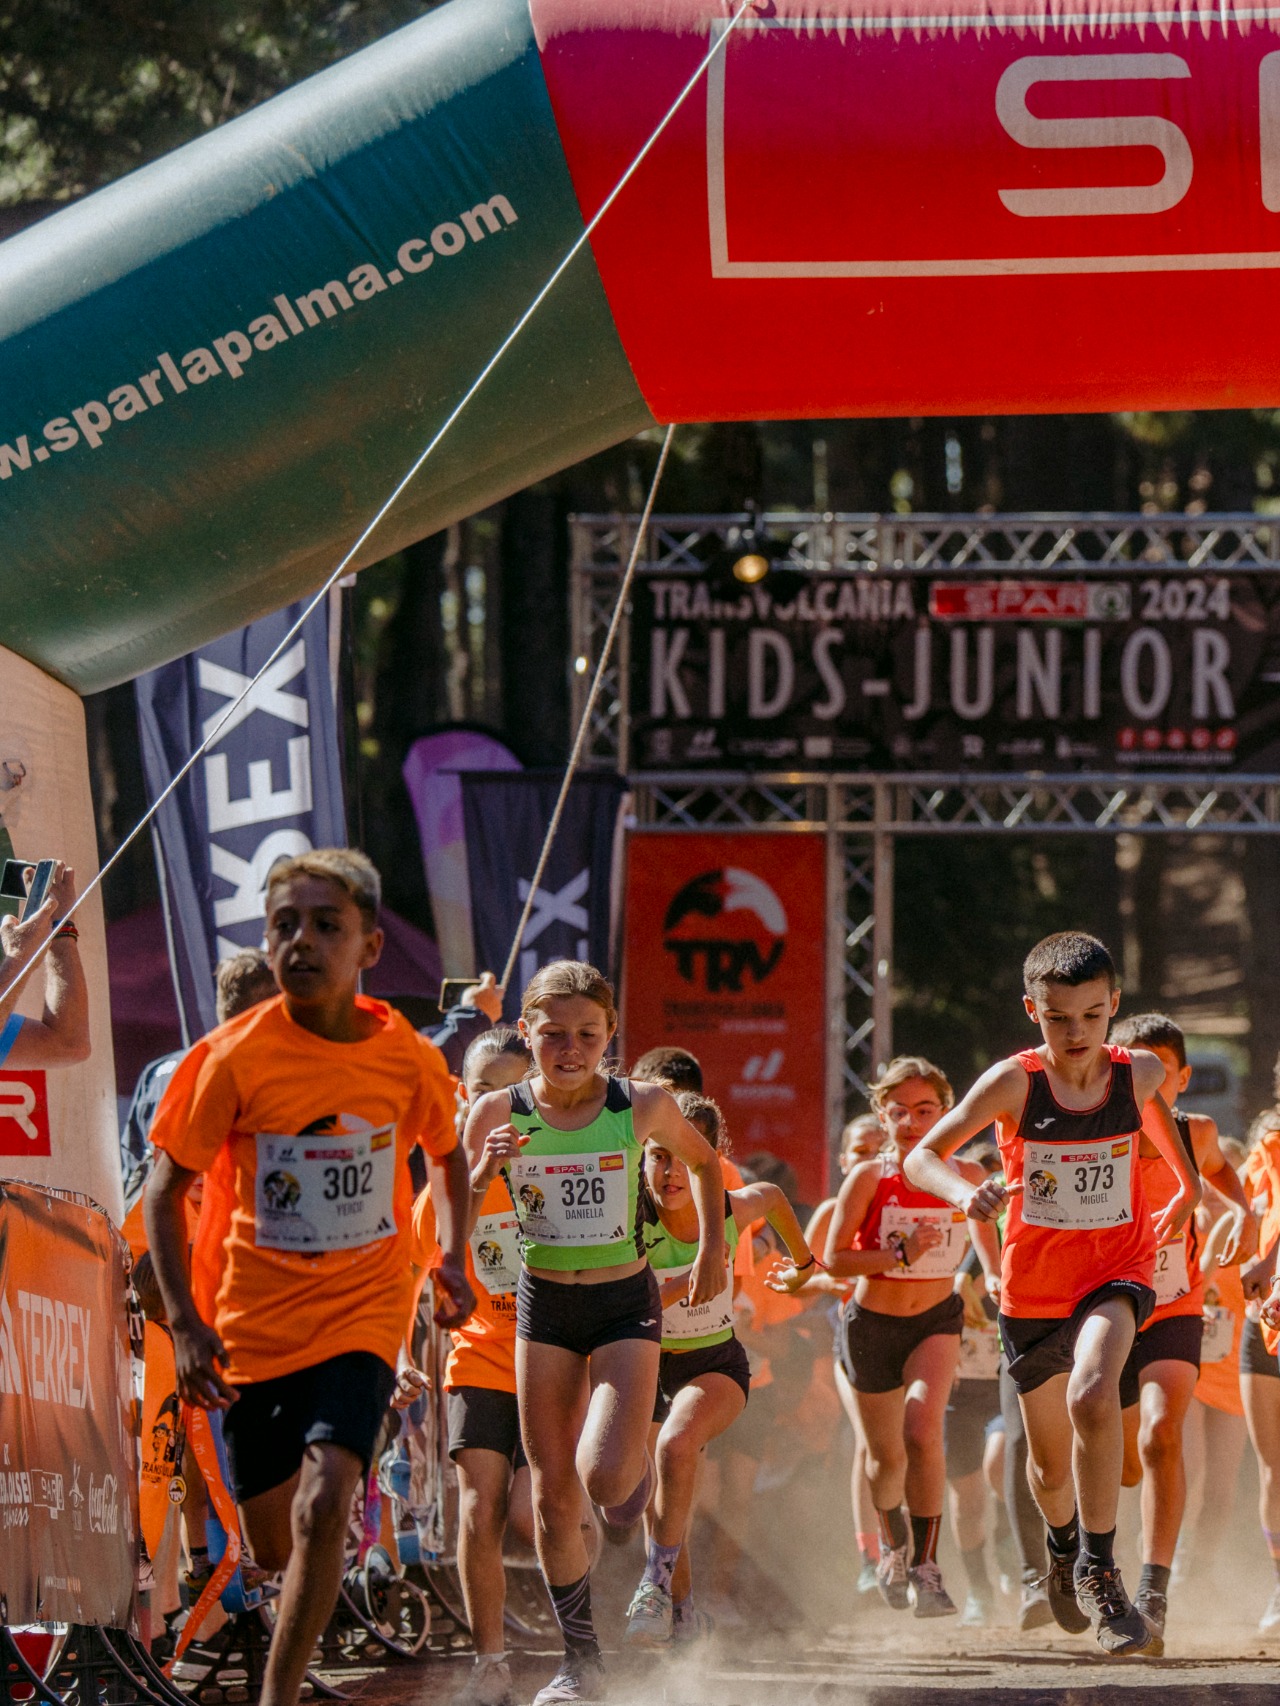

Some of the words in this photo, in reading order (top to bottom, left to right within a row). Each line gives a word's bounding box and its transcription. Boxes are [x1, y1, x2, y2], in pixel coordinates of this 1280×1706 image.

[1139, 578, 1231, 620] 2024
[649, 626, 1236, 720] KIDS-JUNIOR
[664, 938, 786, 992] TRV
[553, 1165, 584, 1174] SPAR
[1069, 1153, 1098, 1162] SPAR
[324, 1161, 373, 1200] 302
[560, 1177, 606, 1207] 326
[1074, 1164, 1115, 1193] 373
[565, 1207, 605, 1221] DANIELLA
[1080, 1193, 1109, 1206] MIGUEL
[17, 1289, 96, 1412] TERREX
